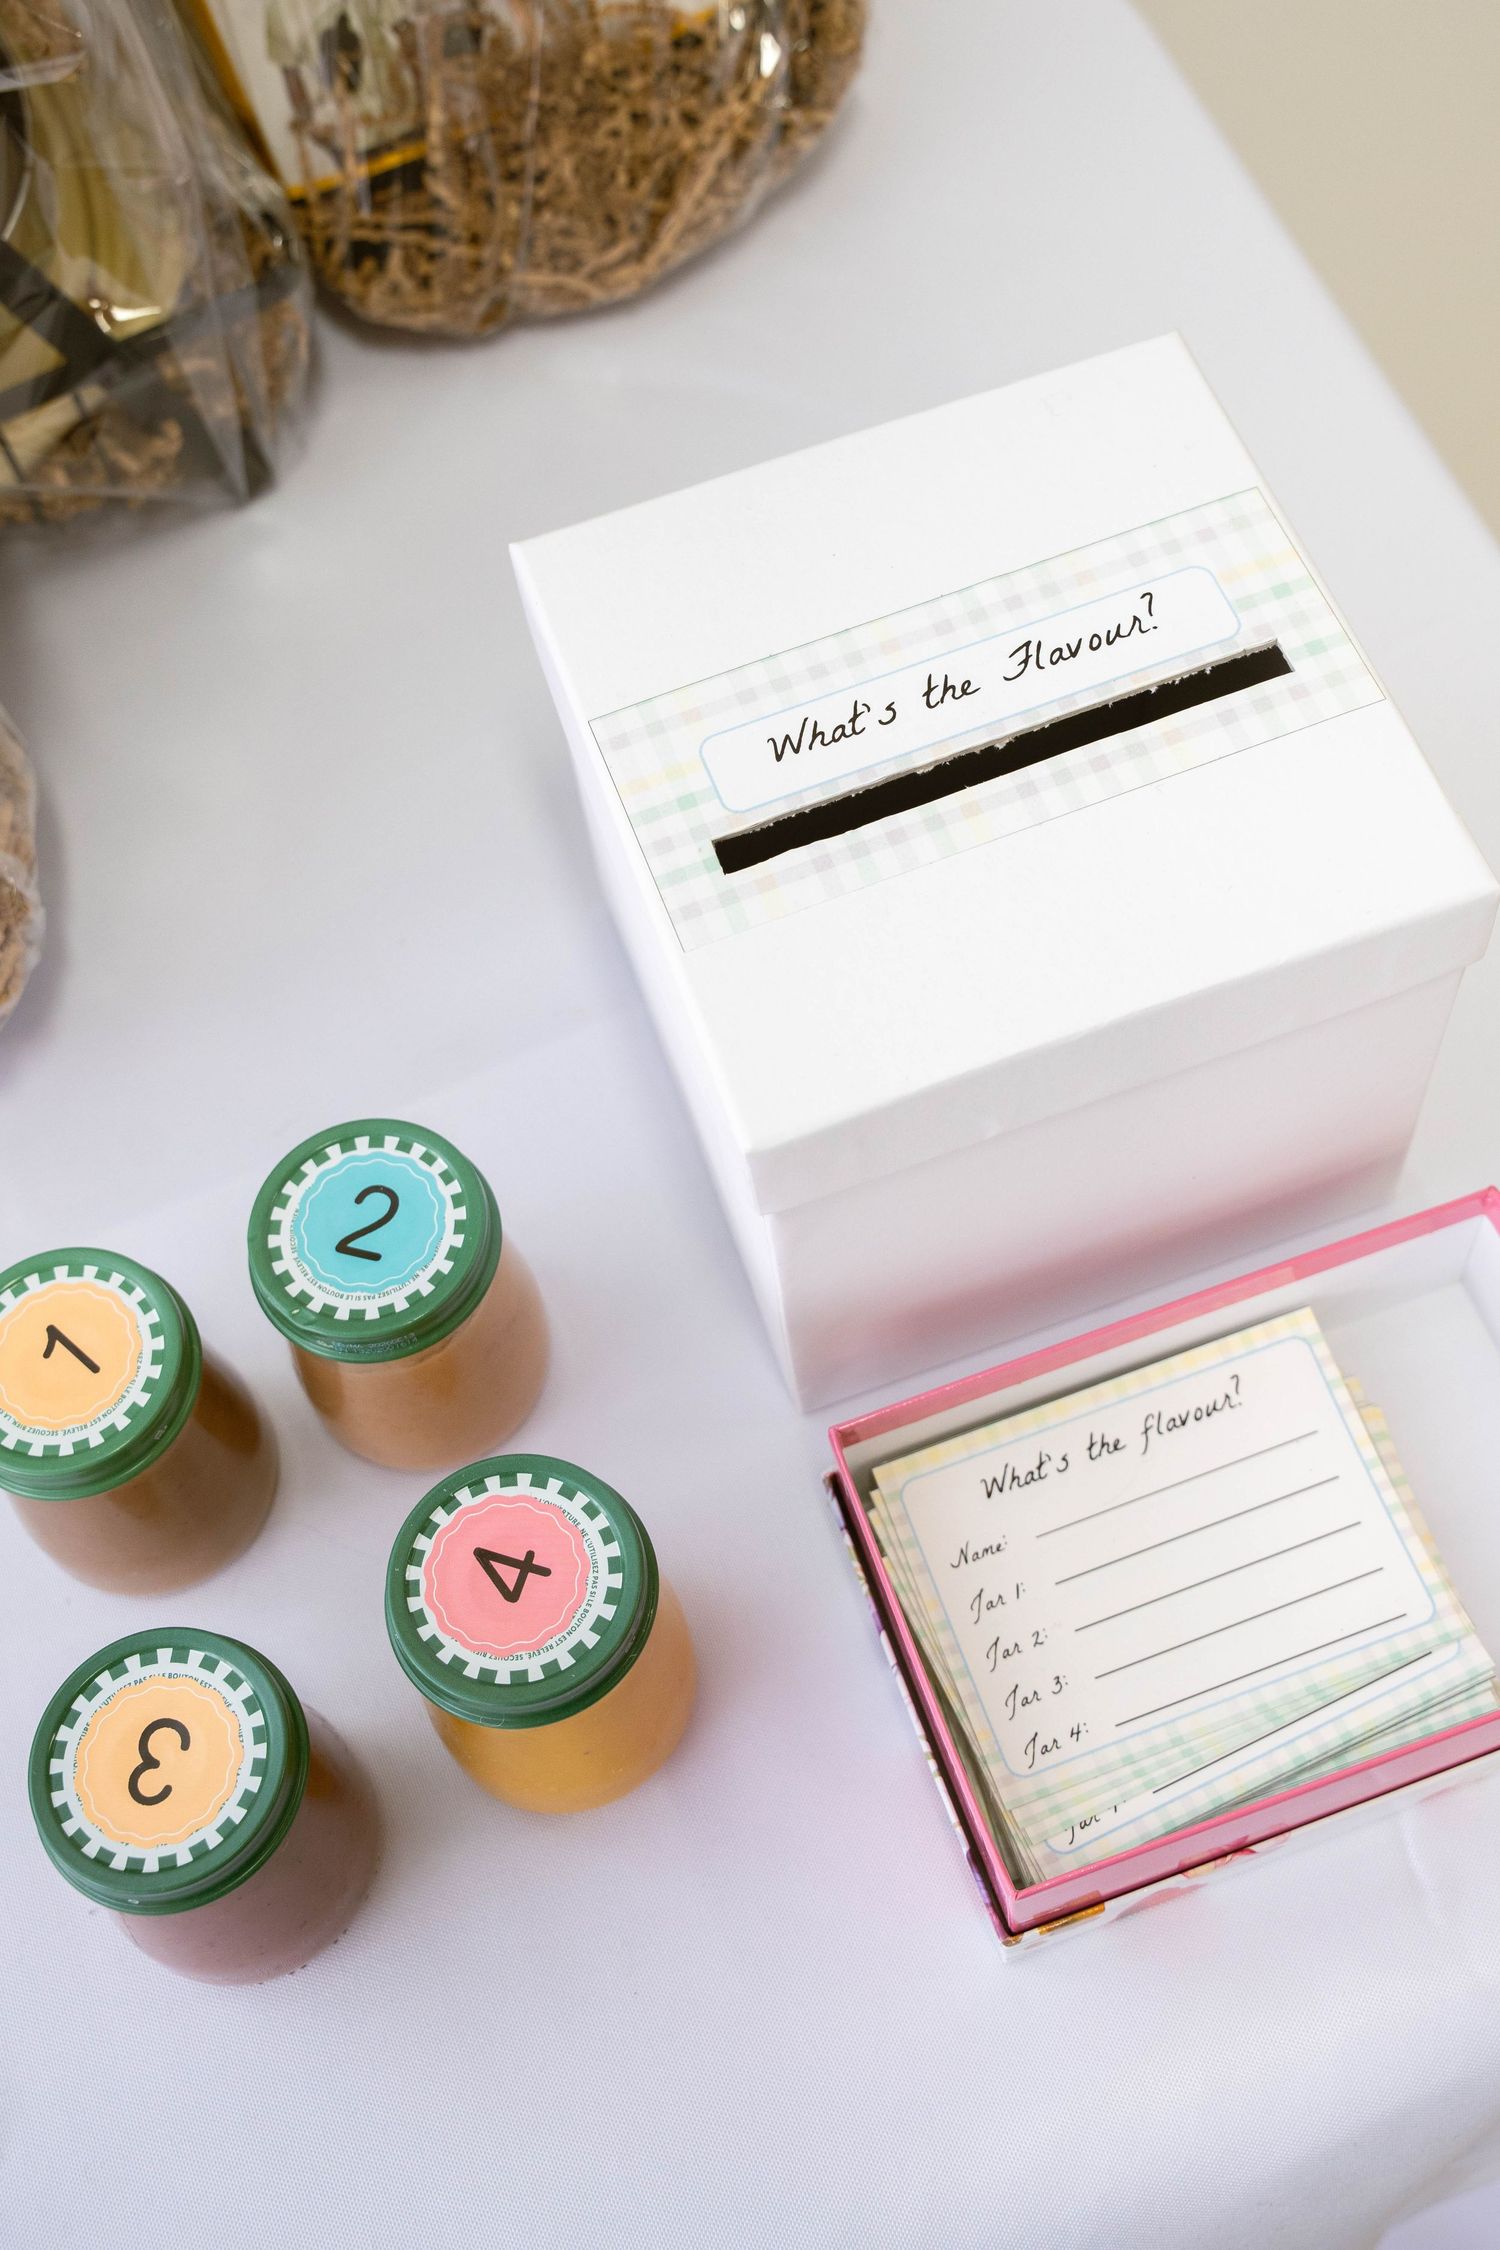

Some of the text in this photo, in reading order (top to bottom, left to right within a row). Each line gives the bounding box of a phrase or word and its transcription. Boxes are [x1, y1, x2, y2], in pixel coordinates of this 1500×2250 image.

[767, 592, 1160, 763] What's the Flavour?
[334, 1184, 400, 1262] 2
[42, 1323, 101, 1374] 1
[981, 1374, 1243, 1499] What's the flavour?
[473, 1546, 552, 1604] 4
[951, 1534, 1008, 1569] Name:
[590, 1575, 599, 1590] PAS
[970, 1582, 1027, 1625] Jar 1:
[554, 1635, 567, 1647] EST
[566, 1608, 590, 1637] BOUTON
[986, 1628, 1049, 1673] Jar 2:
[1004, 1674, 1069, 1721] Jar 3:
[127, 1717, 191, 1806] 3
[1024, 1722, 1090, 1769] Jar 4:
